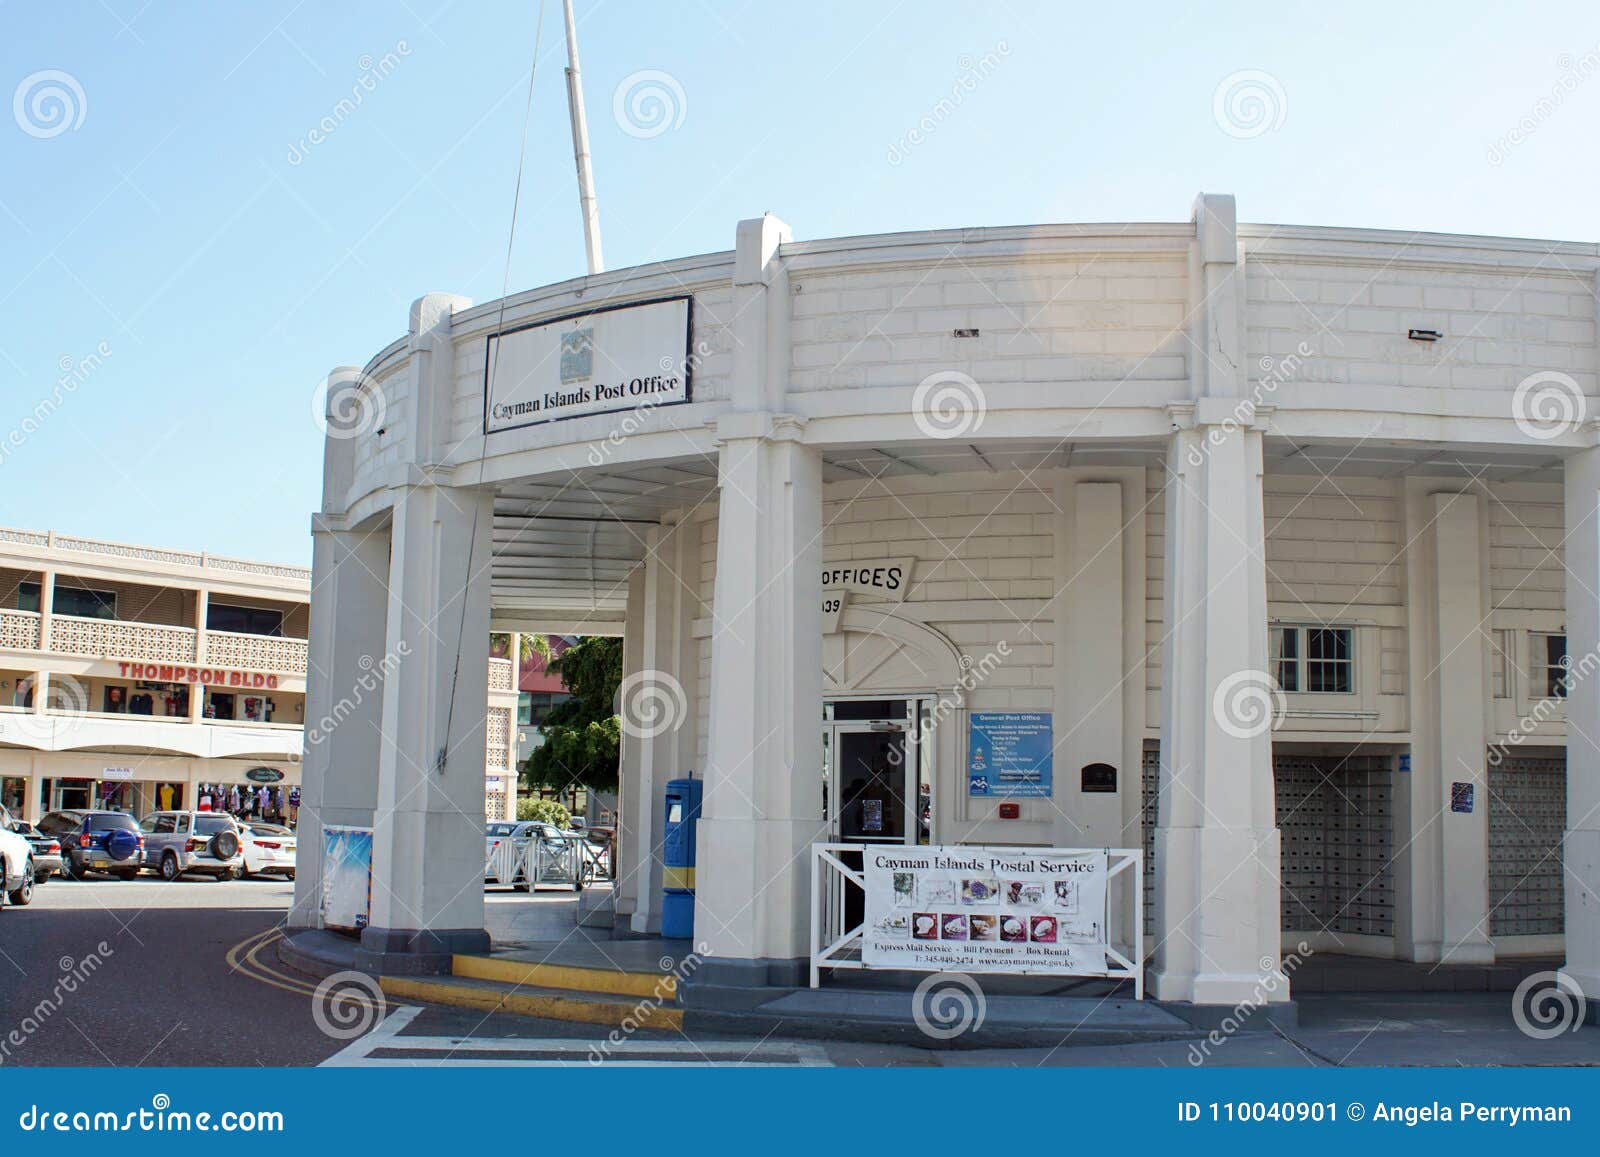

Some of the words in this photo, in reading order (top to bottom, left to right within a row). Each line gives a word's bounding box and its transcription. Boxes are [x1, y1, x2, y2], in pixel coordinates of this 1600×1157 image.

[493, 399, 540, 420] Cayman
[543, 387, 590, 410] Islands
[595, 382, 625, 401] Post
[629, 375, 678, 396] Office
[822, 567, 902, 590] OFFICES
[822, 600, 840, 613] 39
[118, 662, 226, 685] THOMPSON
[229, 671, 278, 689] BLDG
[875, 856, 929, 870] Cayman
[934, 856, 985, 870] Islands
[990, 858, 1034, 873] Postal
[1039, 860, 1095, 873] Service
[874, 943, 904, 952] Express
[906, 943, 923, 951] Mail
[924, 943, 952, 952] Service
[963, 945, 977, 954] Bill
[979, 945, 1014, 955] Payment
[1026, 946, 1042, 955] Box
[1043, 947, 1070, 956] Rental
